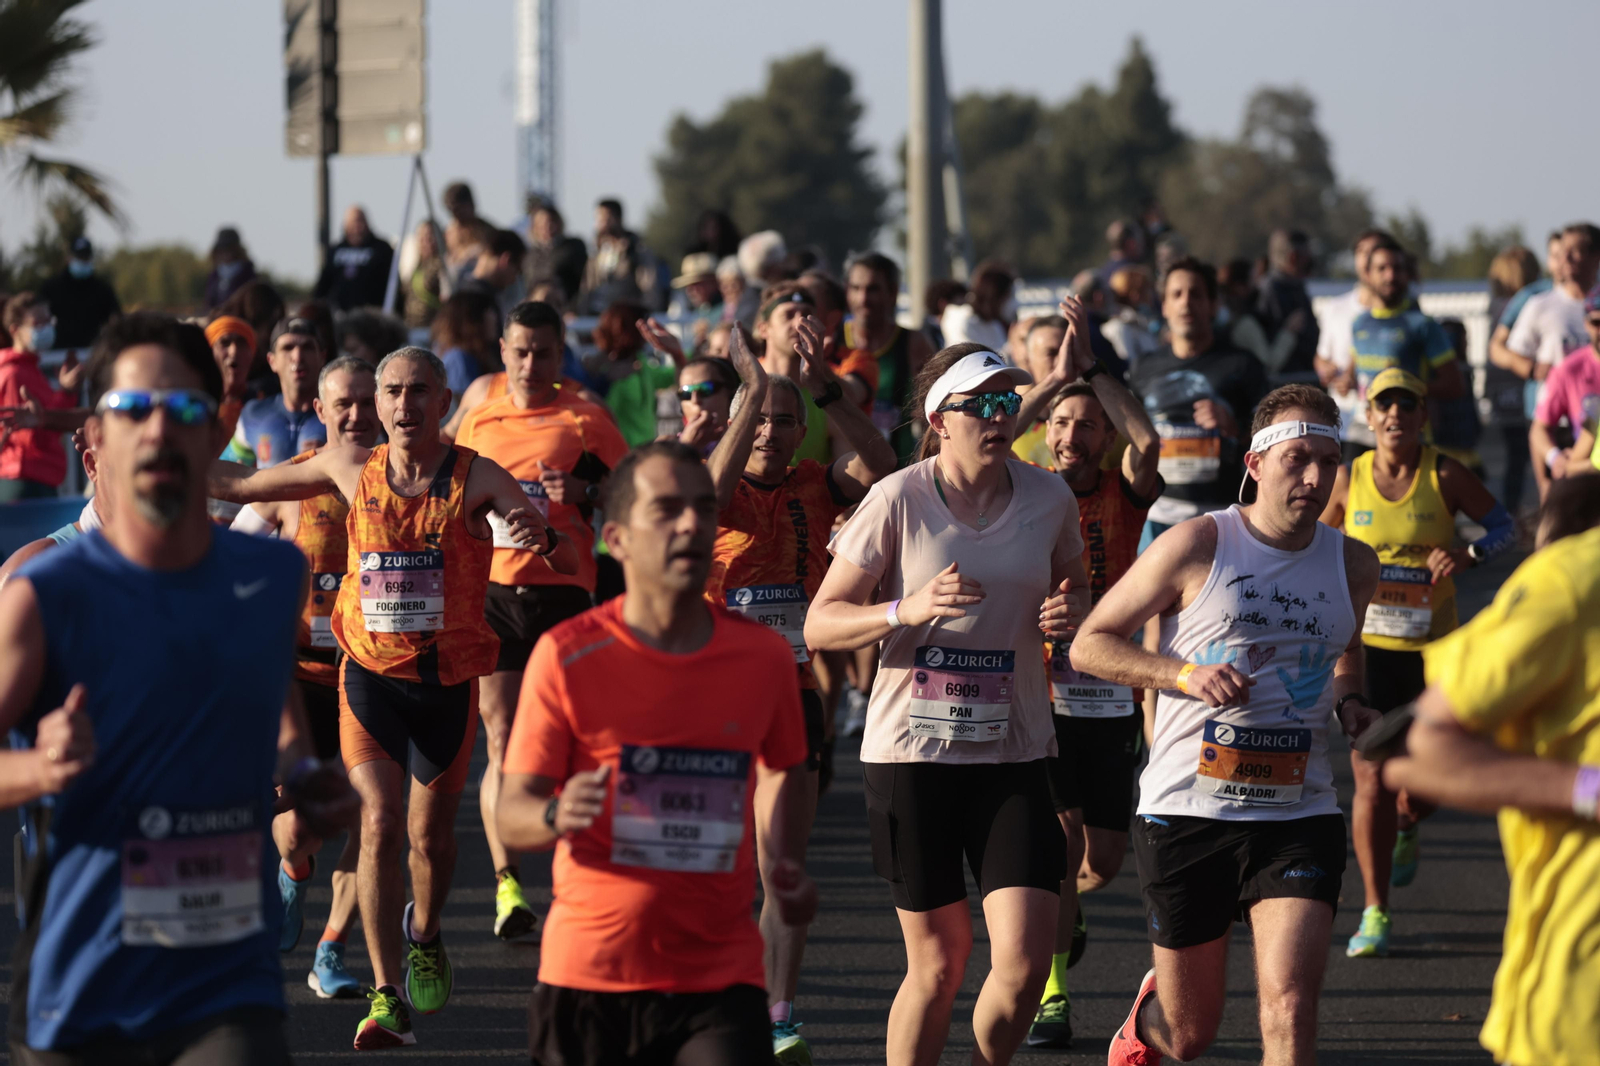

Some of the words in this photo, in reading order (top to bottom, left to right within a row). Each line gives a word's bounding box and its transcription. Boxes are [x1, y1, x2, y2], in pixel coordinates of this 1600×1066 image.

[1252, 427, 1297, 451] SCOTT
[384, 556, 433, 567] ZURICH
[1087, 520, 1107, 604] RCHENA
[1381, 567, 1426, 580] ZURICH
[385, 581, 414, 593] 6952
[756, 588, 800, 600] ZURICH
[376, 601, 426, 611] FOGONERO
[758, 614, 787, 626] 9575
[947, 654, 1003, 667] ZURICH
[945, 682, 980, 698] 6909
[1068, 687, 1114, 698] MANOLITO
[949, 706, 973, 718] PAN
[1238, 733, 1299, 747] ZURICH
[663, 753, 738, 773] ZURICH
[1235, 762, 1272, 779] 4909
[1224, 785, 1276, 799] ALBADRI
[176, 808, 253, 833] ZURICH
